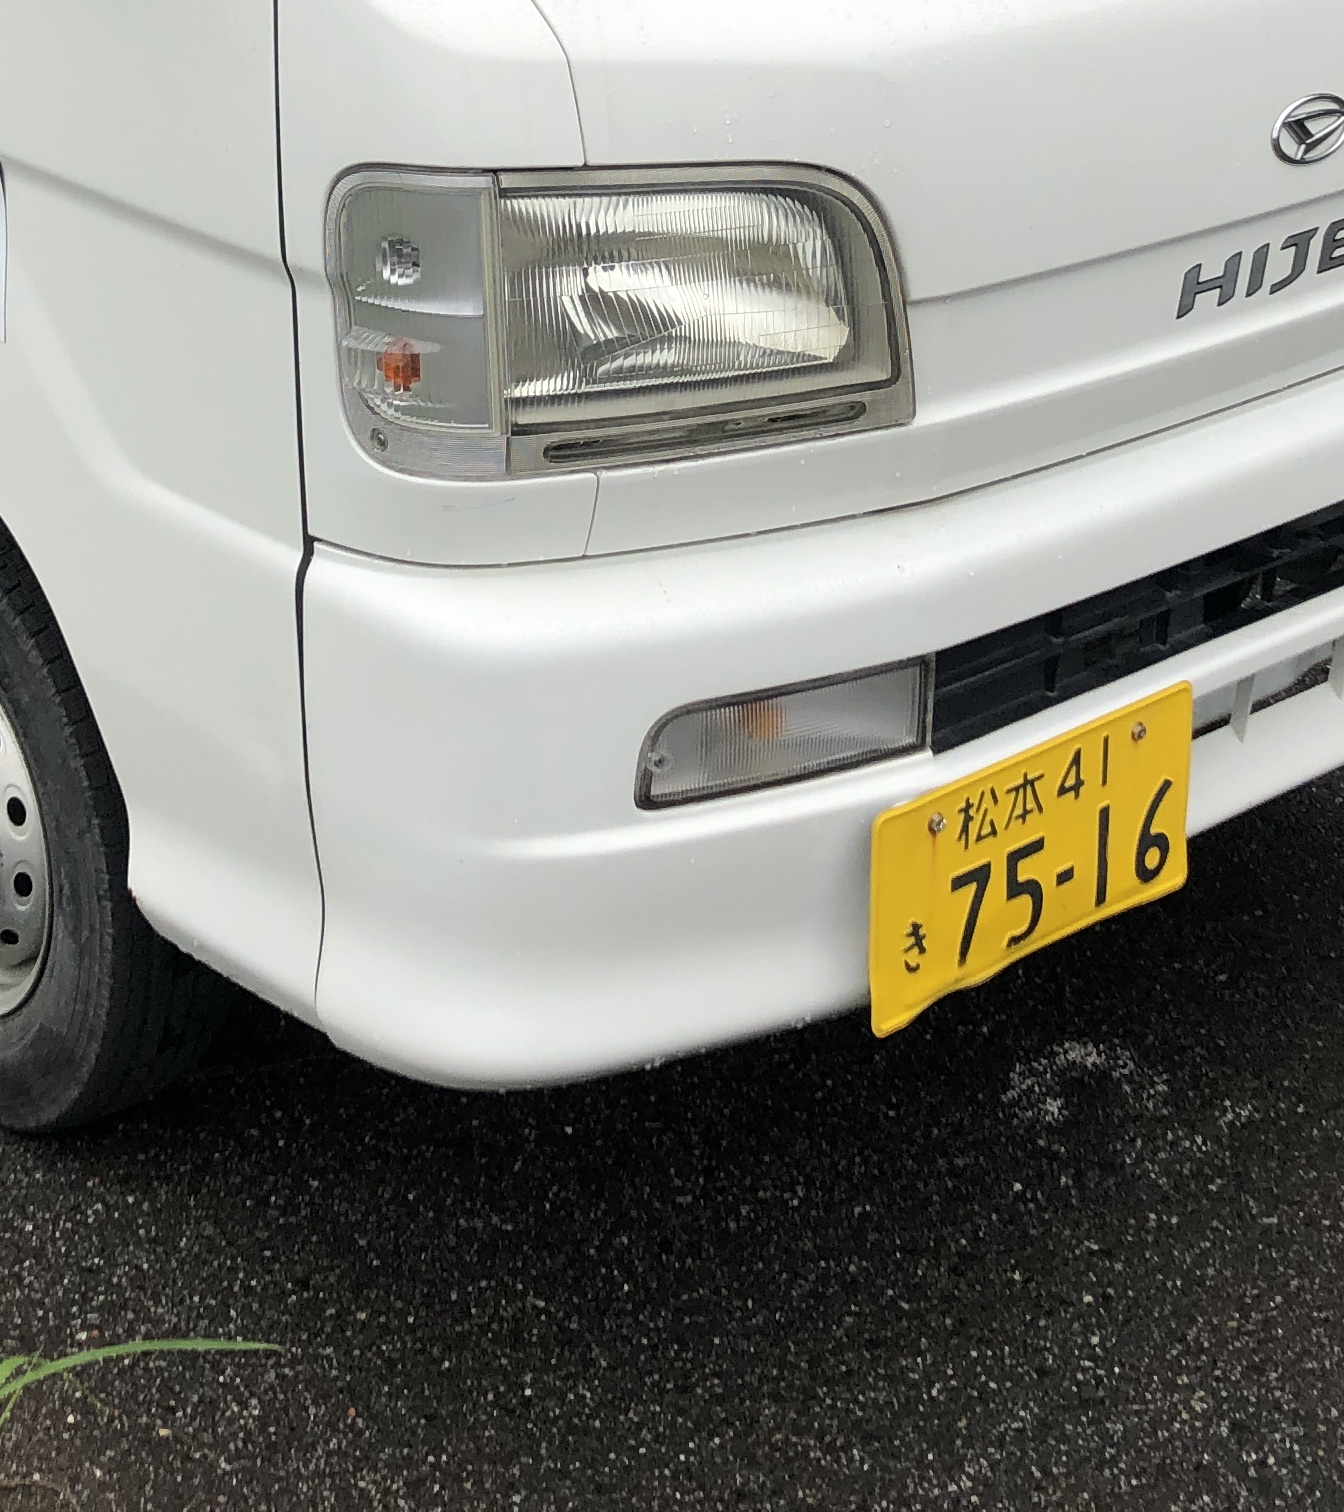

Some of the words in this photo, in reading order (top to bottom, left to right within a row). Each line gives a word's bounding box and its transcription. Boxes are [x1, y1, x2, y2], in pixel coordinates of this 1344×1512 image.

[957, 772, 1045, 851] 松本
[1056, 734, 1110, 801] 41
[902, 920, 927, 975] き
[950, 777, 1174, 968] 75-16
